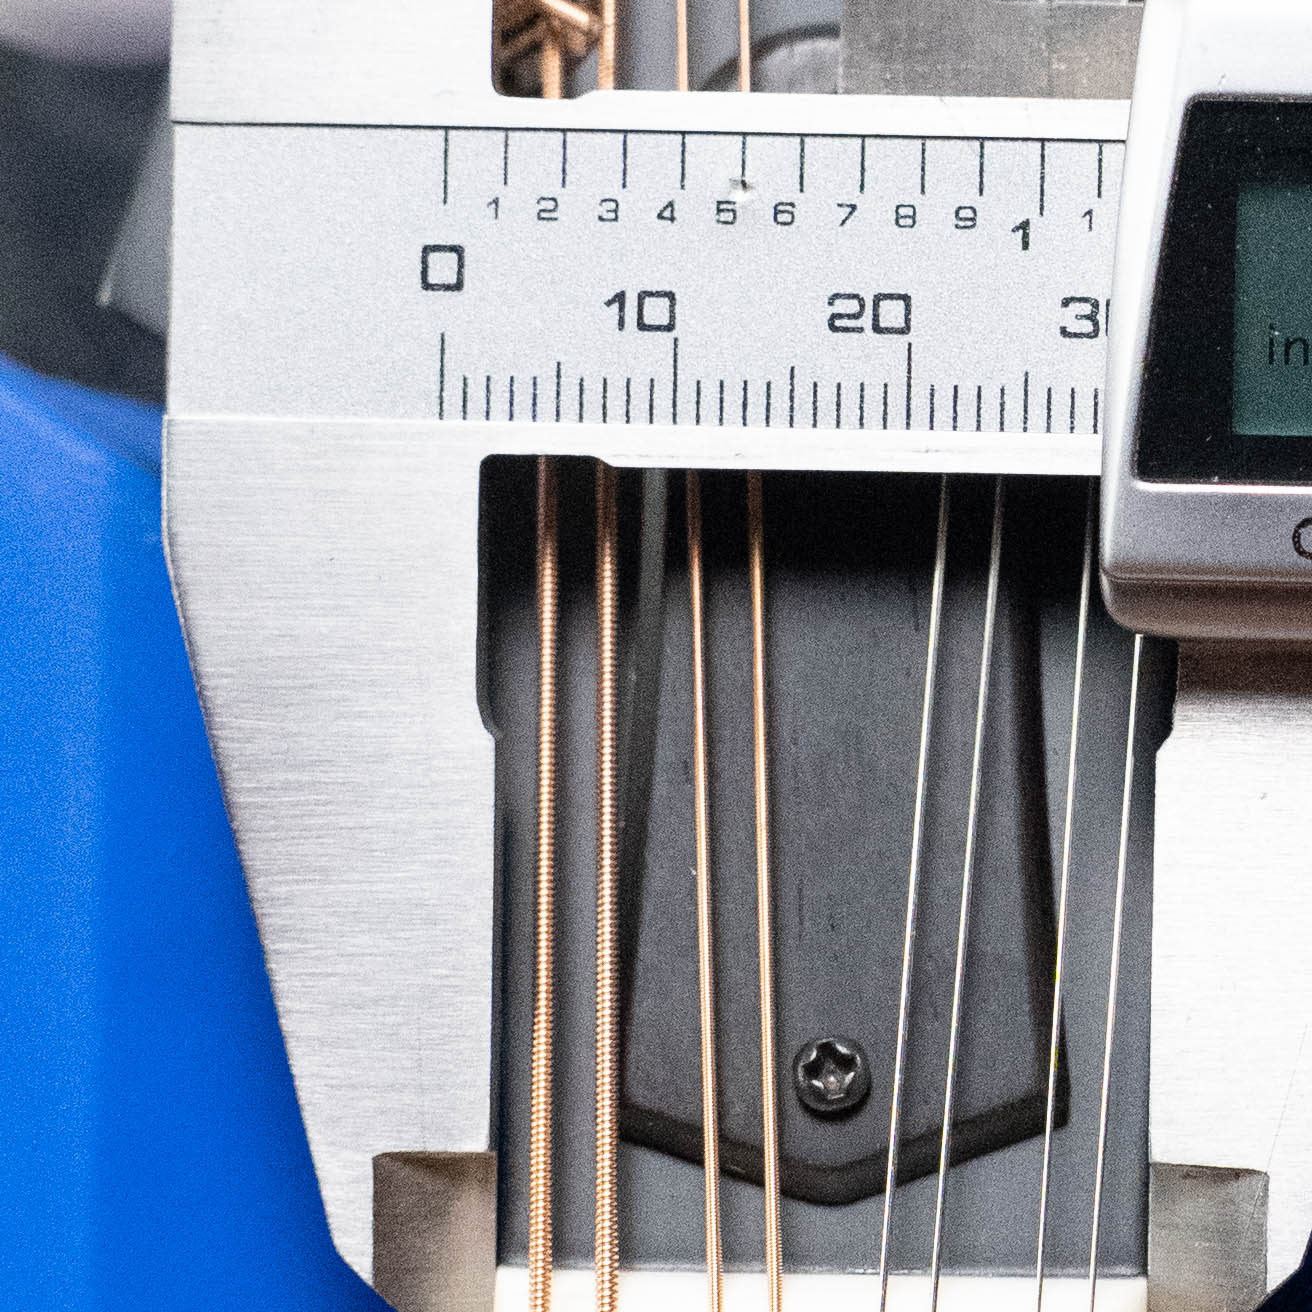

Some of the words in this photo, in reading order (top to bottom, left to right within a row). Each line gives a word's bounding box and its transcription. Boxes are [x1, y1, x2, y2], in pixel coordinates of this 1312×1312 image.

[488, 197, 500, 220] 1
[535, 197, 560, 221] 2
[597, 198, 620, 223] 3
[656, 201, 676, 223] 4
[716, 200, 738, 226] 5
[772, 201, 796, 227] 6
[836, 202, 858, 228] 7
[894, 204, 918, 229] 8
[954, 205, 978, 231] 9
[1011, 218, 1031, 251] 1
[604, 290, 677, 333] 10
[827, 292, 912, 335] 20
[1059, 296, 1110, 340] 3
[1267, 324, 1311, 367] in
